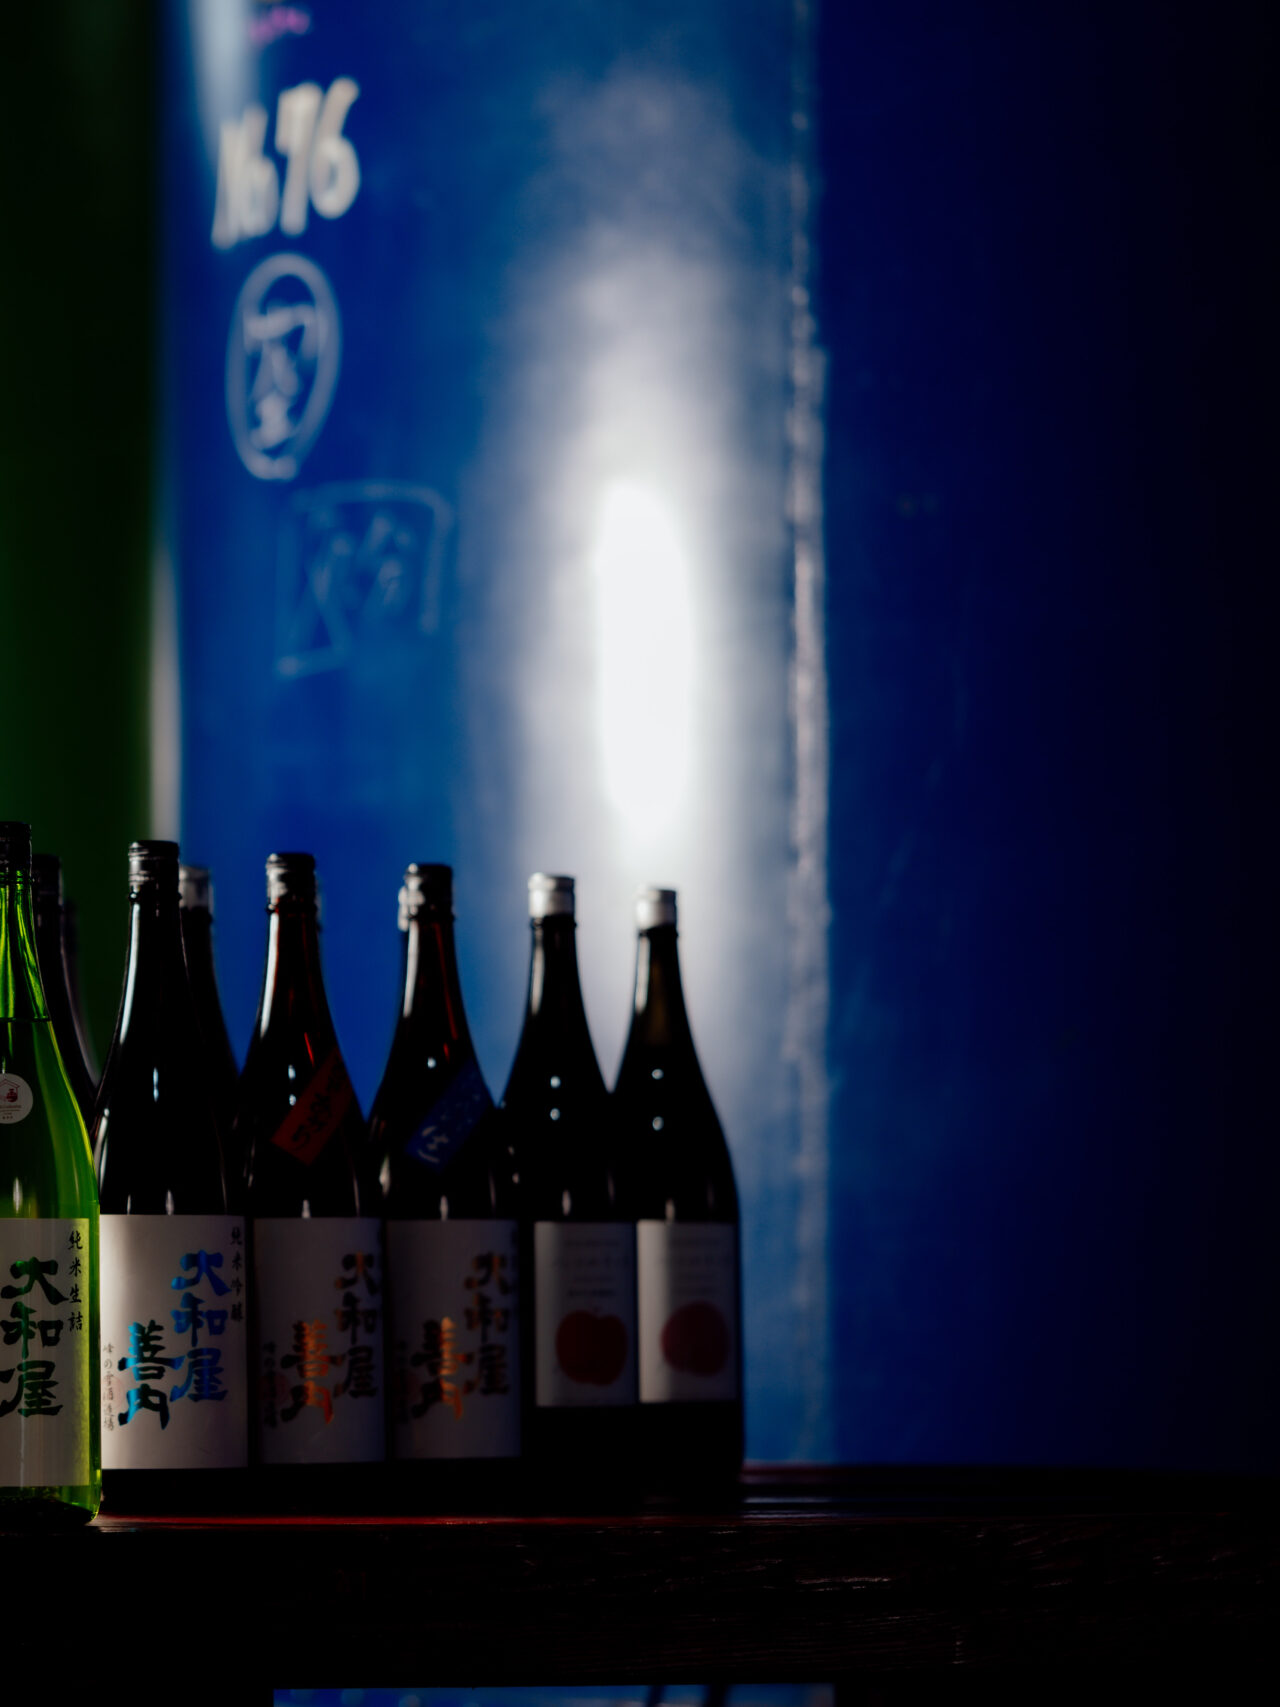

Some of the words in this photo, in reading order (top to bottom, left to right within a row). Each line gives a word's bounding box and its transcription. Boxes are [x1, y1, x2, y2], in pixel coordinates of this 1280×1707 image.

[68, 1230, 85, 1332] 純米生詰
[169, 1249, 233, 1403] 大和屋
[333, 1252, 380, 1398] 大和屋
[464, 1252, 510, 1396] 大和屋
[118, 1320, 186, 1430] 善内
[281, 1319, 344, 1425] 善内
